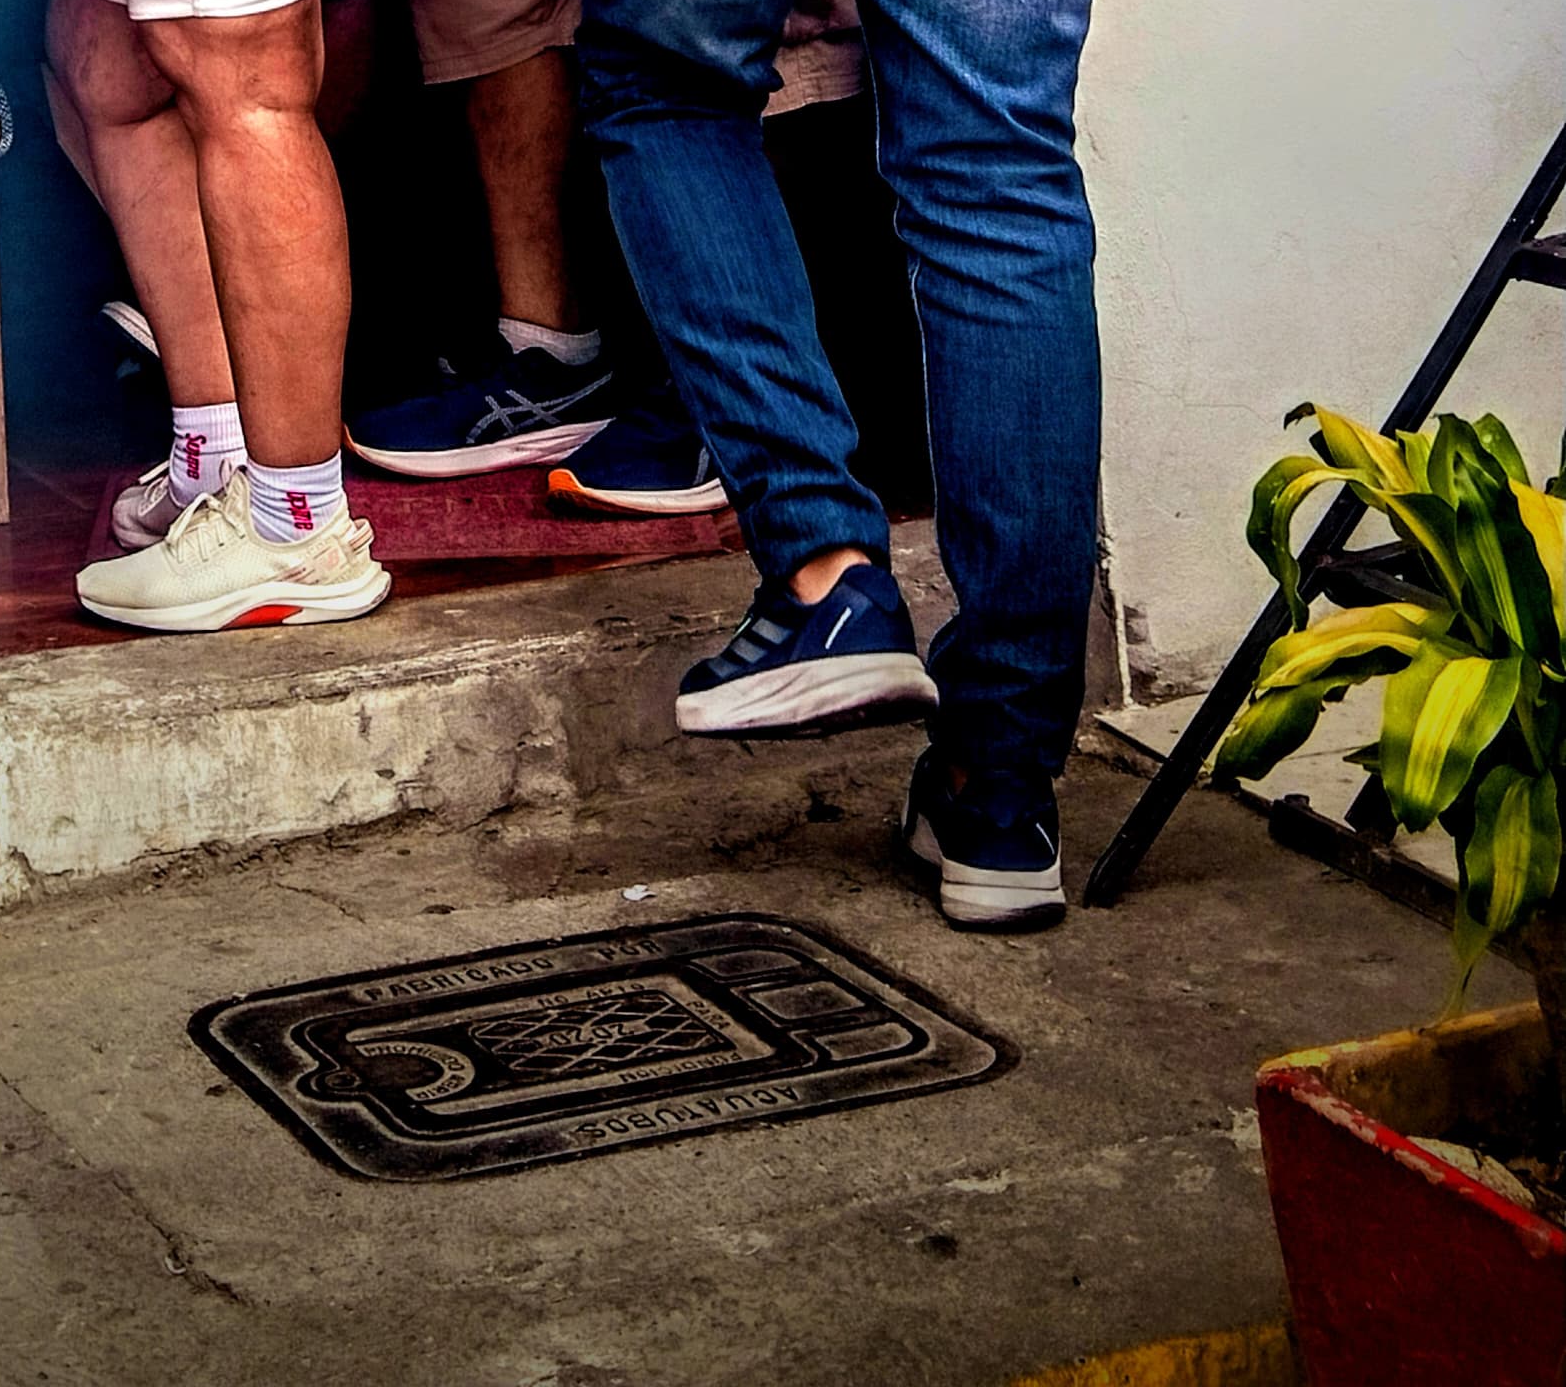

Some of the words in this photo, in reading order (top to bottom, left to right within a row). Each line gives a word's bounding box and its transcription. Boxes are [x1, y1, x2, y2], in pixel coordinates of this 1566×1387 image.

[364, 958, 554, 1001] FABRICADO
[597, 939, 664, 961] POR
[575, 1085, 801, 1139] ACUATUBOS
